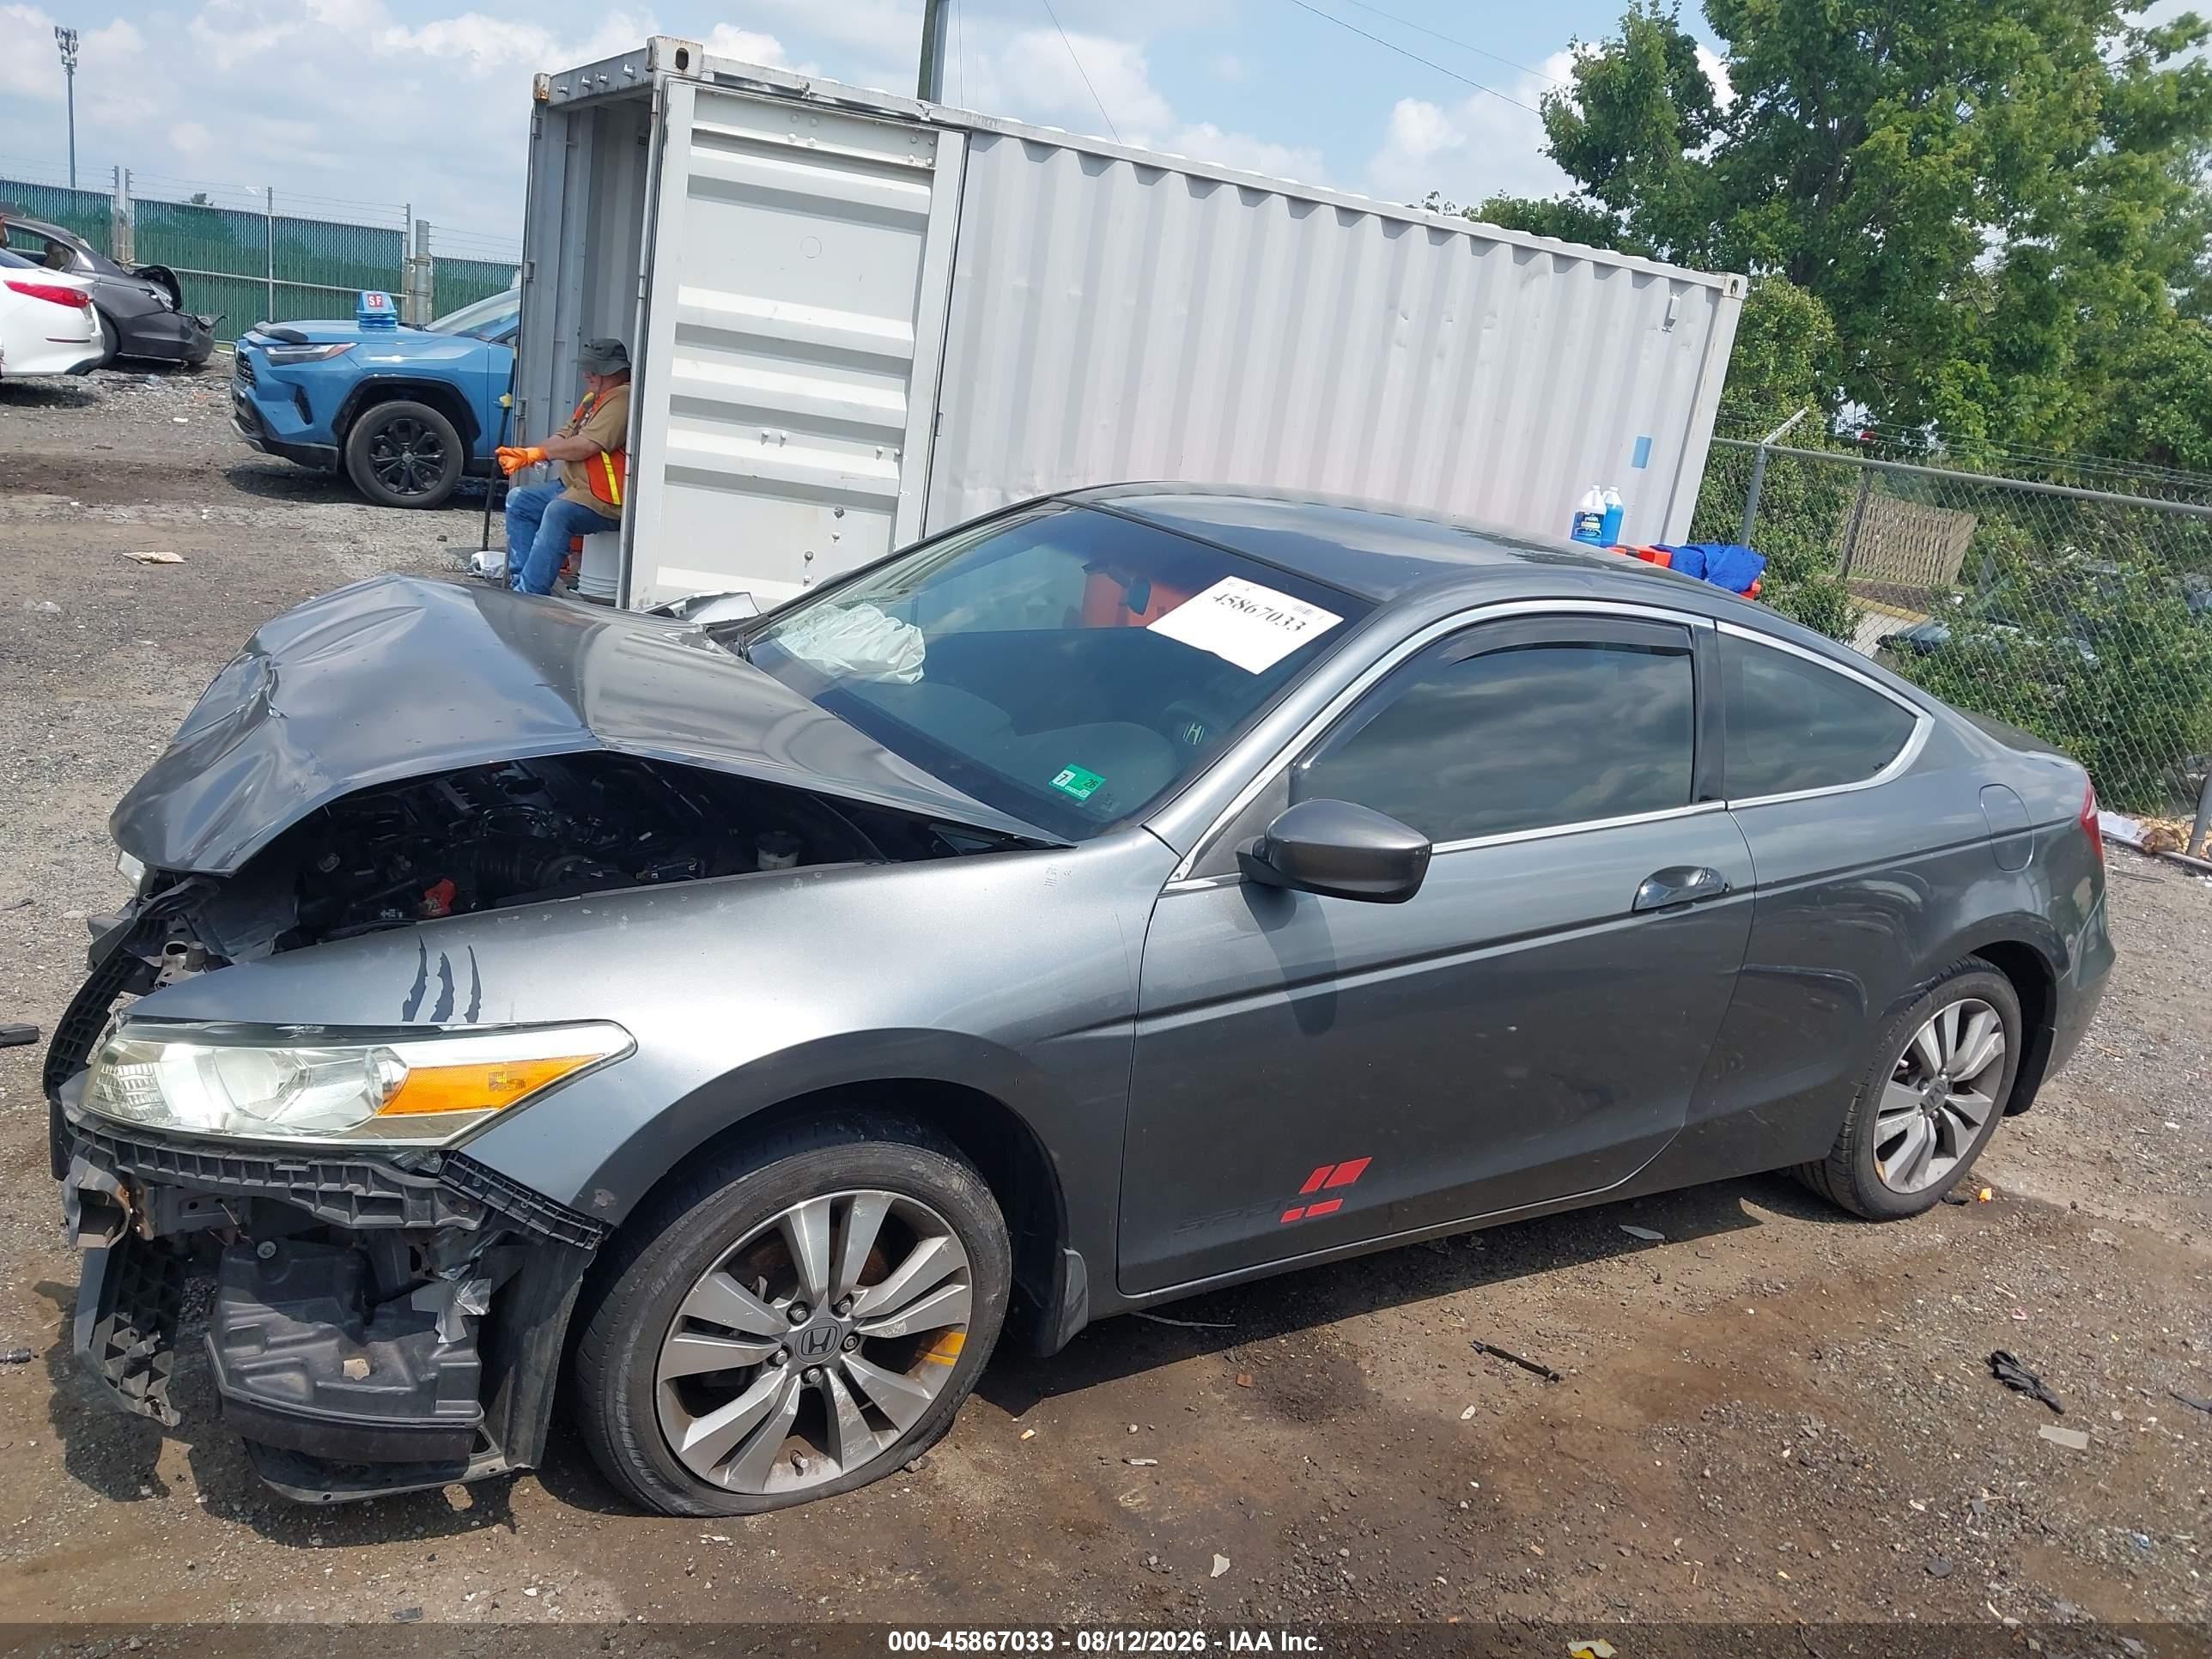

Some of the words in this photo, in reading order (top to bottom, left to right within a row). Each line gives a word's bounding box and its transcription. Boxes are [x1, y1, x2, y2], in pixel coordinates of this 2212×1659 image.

[1212, 592, 1307, 632] 45867033
[1056, 773, 1070, 783] 7
[1083, 778, 1099, 789] 26
